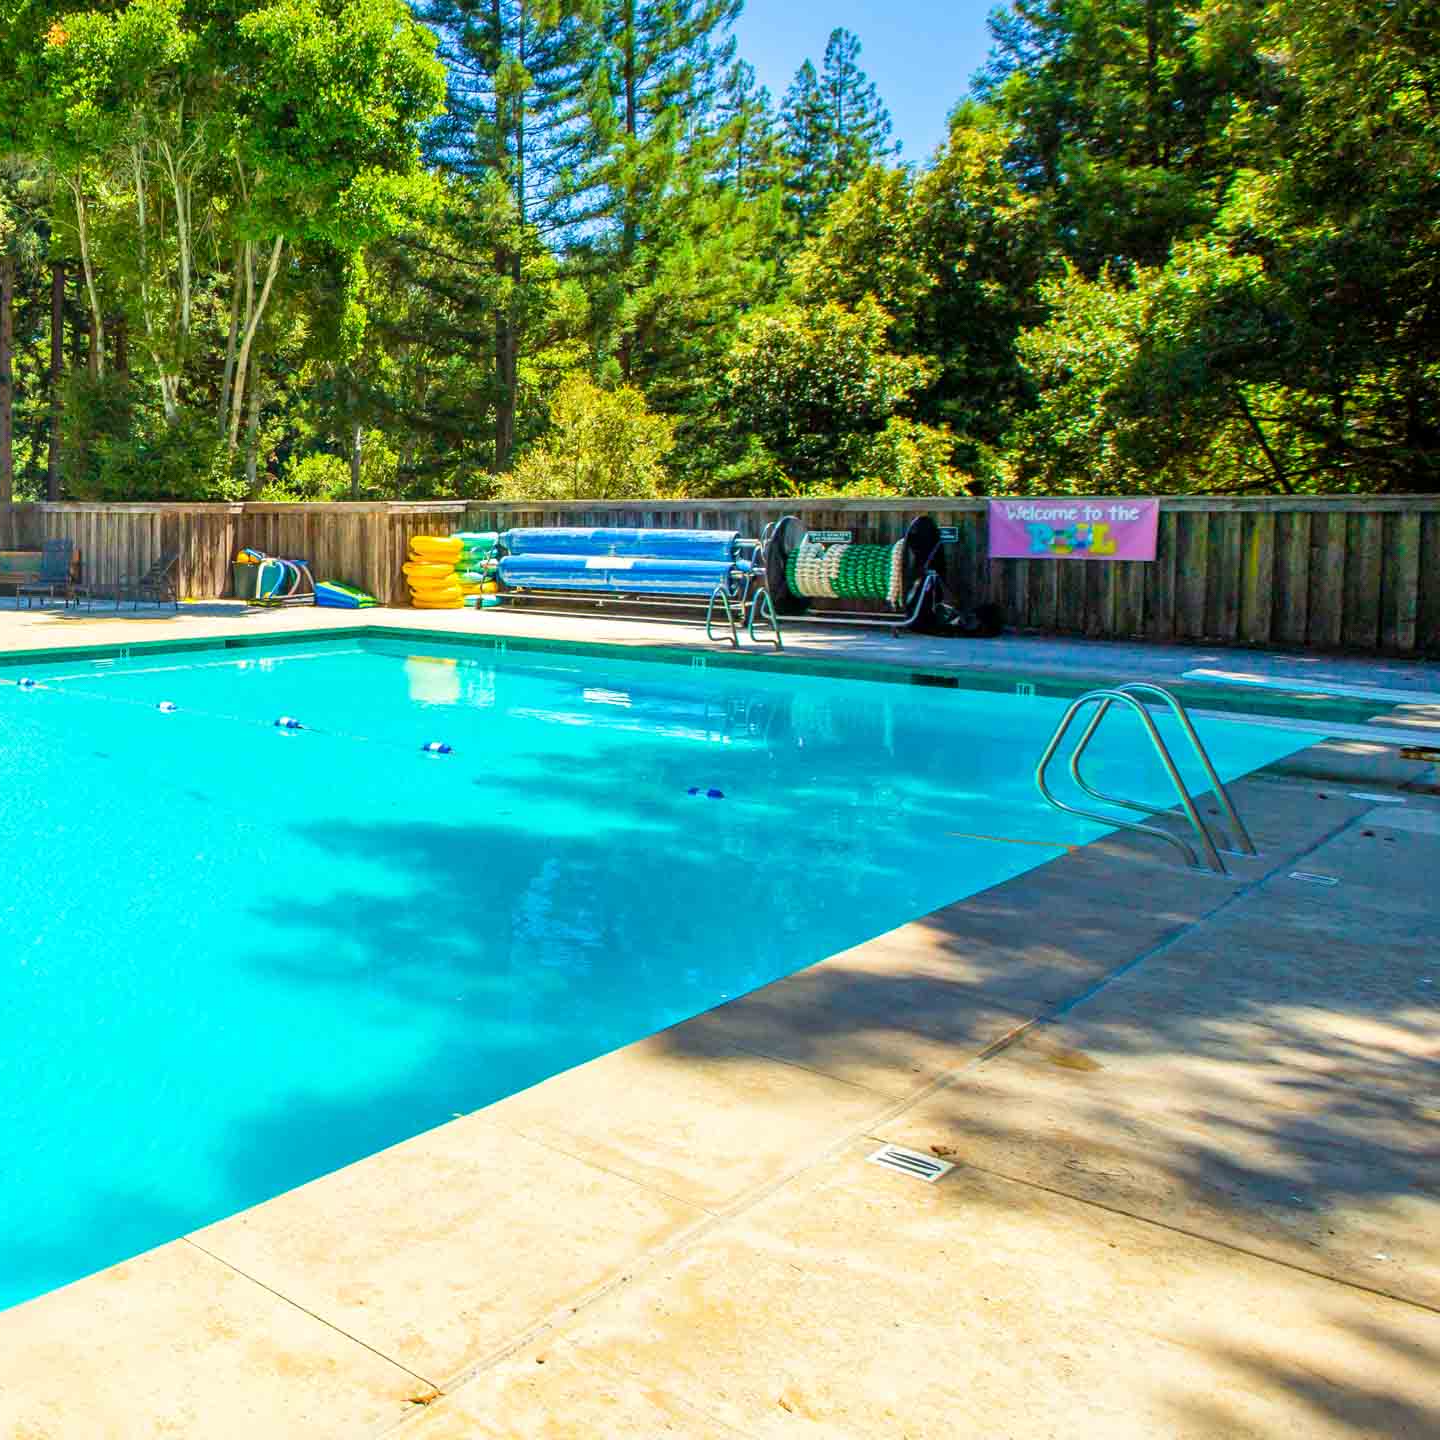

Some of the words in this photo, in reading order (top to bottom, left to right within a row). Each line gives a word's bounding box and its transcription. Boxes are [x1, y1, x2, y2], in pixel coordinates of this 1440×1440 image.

[1007, 505, 1079, 521] Welcome
[1085, 505, 1103, 521] to
[1110, 505, 1140, 521] the
[1026, 522, 1119, 556] POOL
